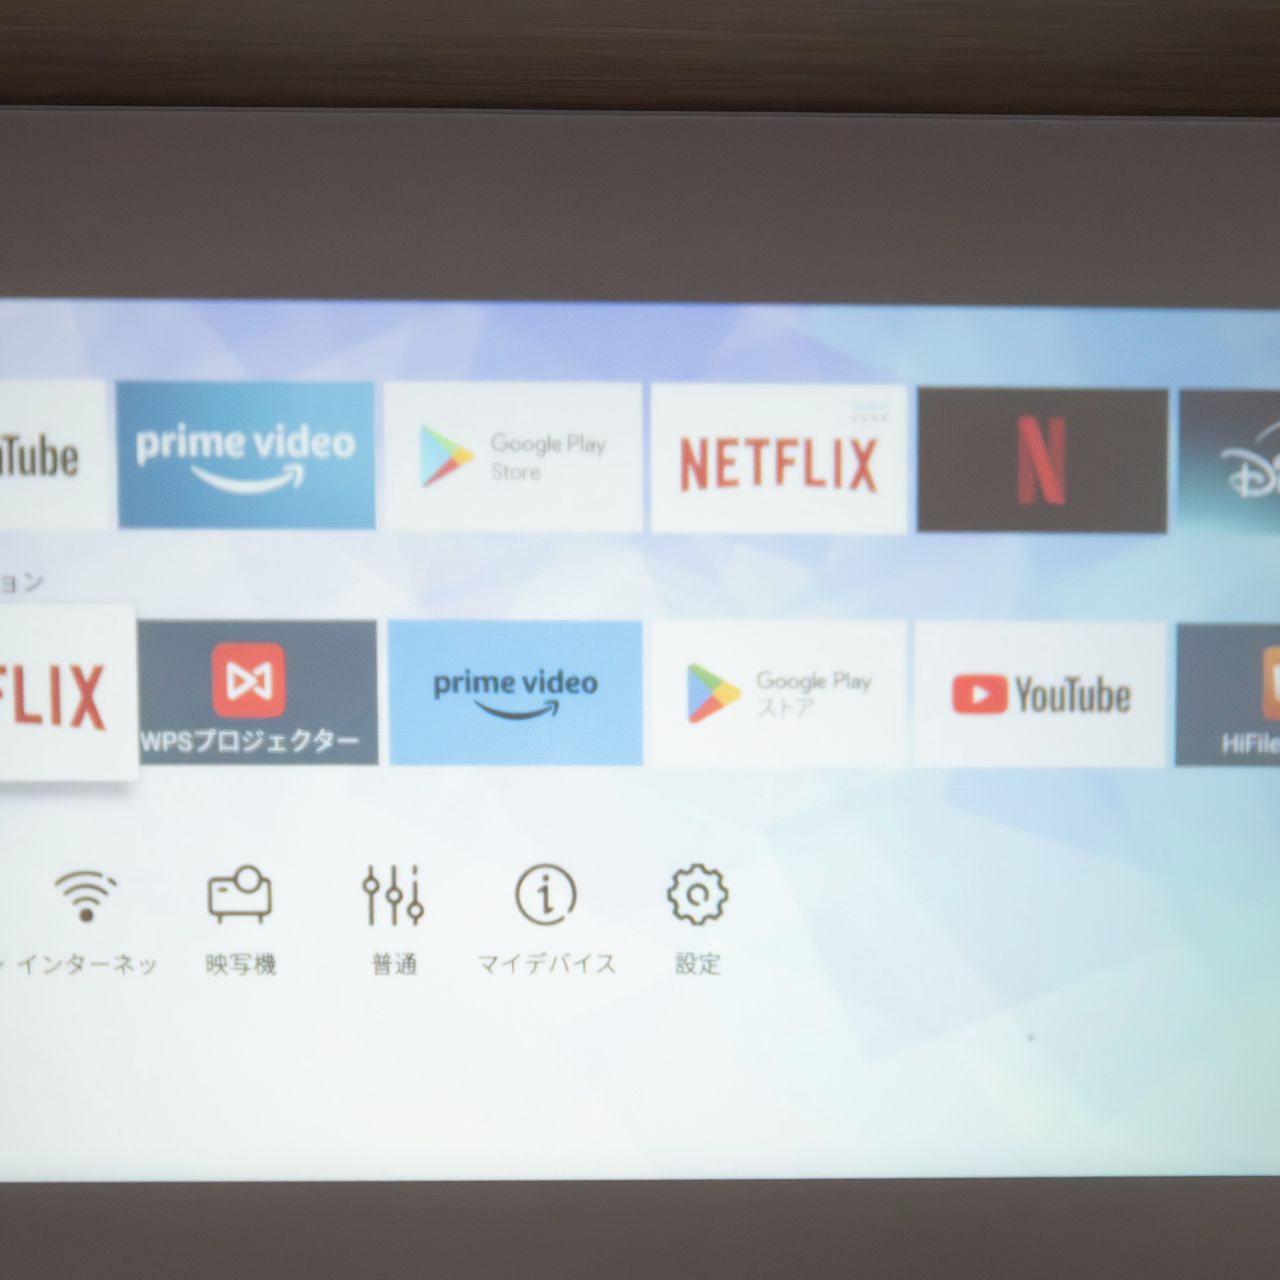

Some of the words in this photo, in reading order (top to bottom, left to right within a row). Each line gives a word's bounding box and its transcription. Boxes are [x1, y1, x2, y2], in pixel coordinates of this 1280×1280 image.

[136, 422, 246, 467] prime
[253, 422, 357, 459] video
[490, 432, 562, 458] Google
[566, 432, 606, 458] Play
[491, 462, 542, 482] Store
[680, 437, 879, 493] NETFLIX
[1017, 416, 1066, 506] N
[433, 669, 516, 700] prime
[522, 669, 599, 695] video
[756, 671, 826, 696] Google
[832, 671, 873, 695] Play
[1016, 676, 1131, 714] YouTube
[758, 698, 815, 718] ストア
[140, 728, 361, 755] WPSプロジェクター
[17, 953, 158, 977] インターネッ
[205, 952, 278, 977] 映写機
[371, 951, 418, 977] 普通
[477, 952, 617, 976] マイデバイス
[674, 952, 722, 977] 設定
